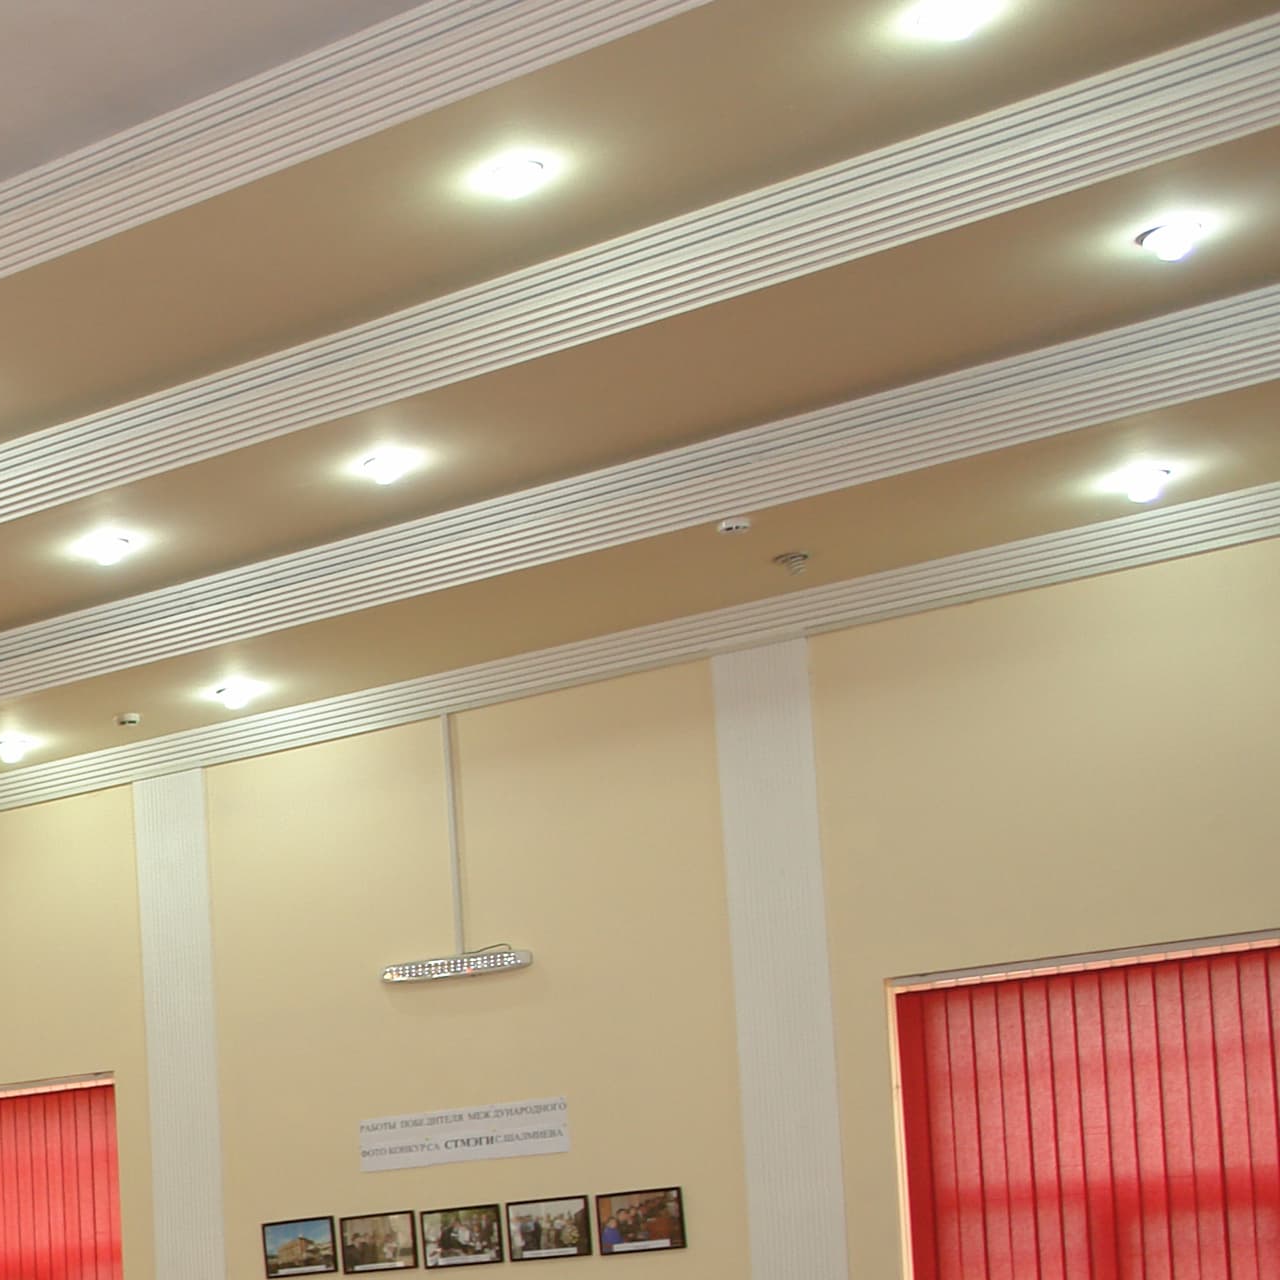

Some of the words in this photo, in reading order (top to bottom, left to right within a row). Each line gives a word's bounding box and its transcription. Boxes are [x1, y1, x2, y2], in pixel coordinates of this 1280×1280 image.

[360, 1122, 397, 1134] РАБОТЫ
[400, 1114, 464, 1128] ПОБЕДИТЕЛЯ
[467, 1101, 567, 1121] МЕЖДУНАРОДНОГО
